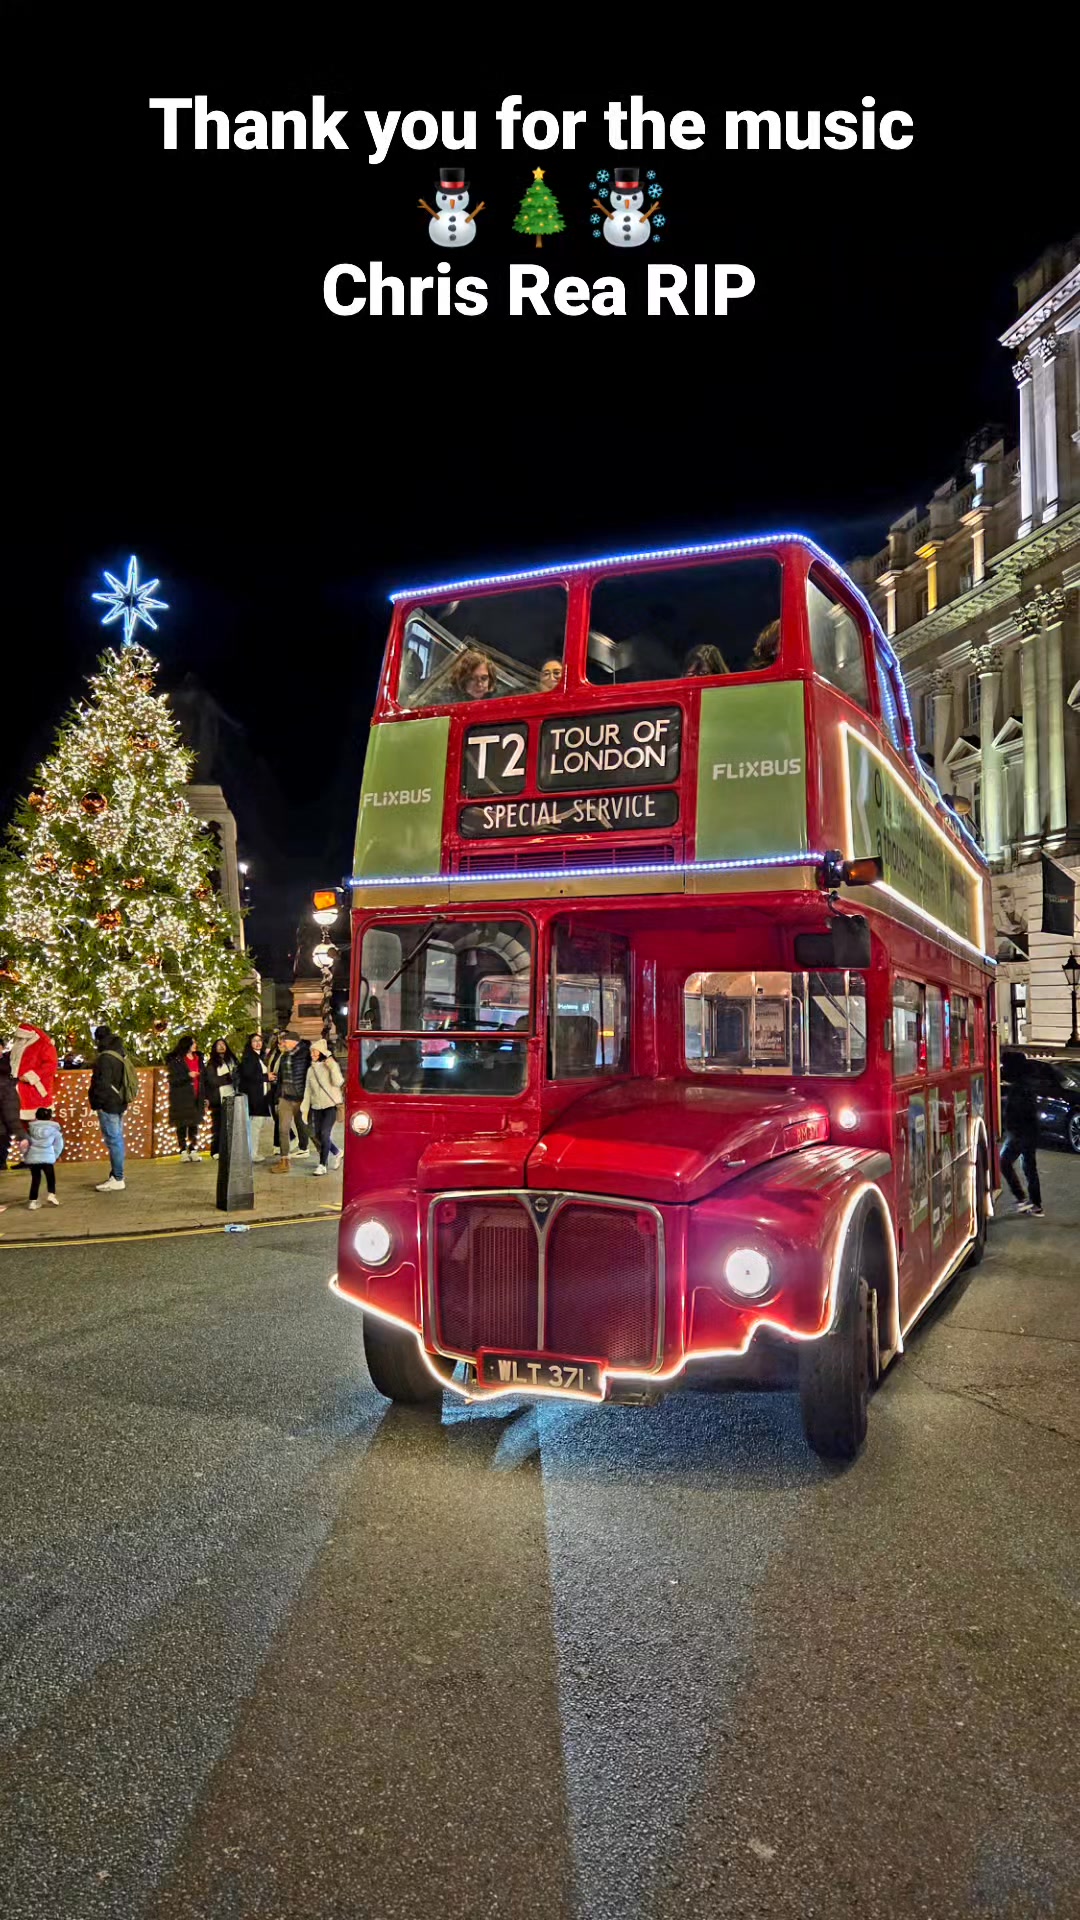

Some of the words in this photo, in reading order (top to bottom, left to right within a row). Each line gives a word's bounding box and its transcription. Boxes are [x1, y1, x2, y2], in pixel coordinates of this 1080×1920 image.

[550, 724, 621, 750] TOUR
[633, 720, 671, 743] OF
[467, 733, 526, 779] T2
[550, 745, 667, 775] LONDON
[483, 801, 563, 829] SPECIAL
[573, 795, 656, 823] SERVICE
[59, 1107, 77, 1118] ST
[498, 1359, 542, 1385] WLT
[548, 1365, 584, 1391] 371
